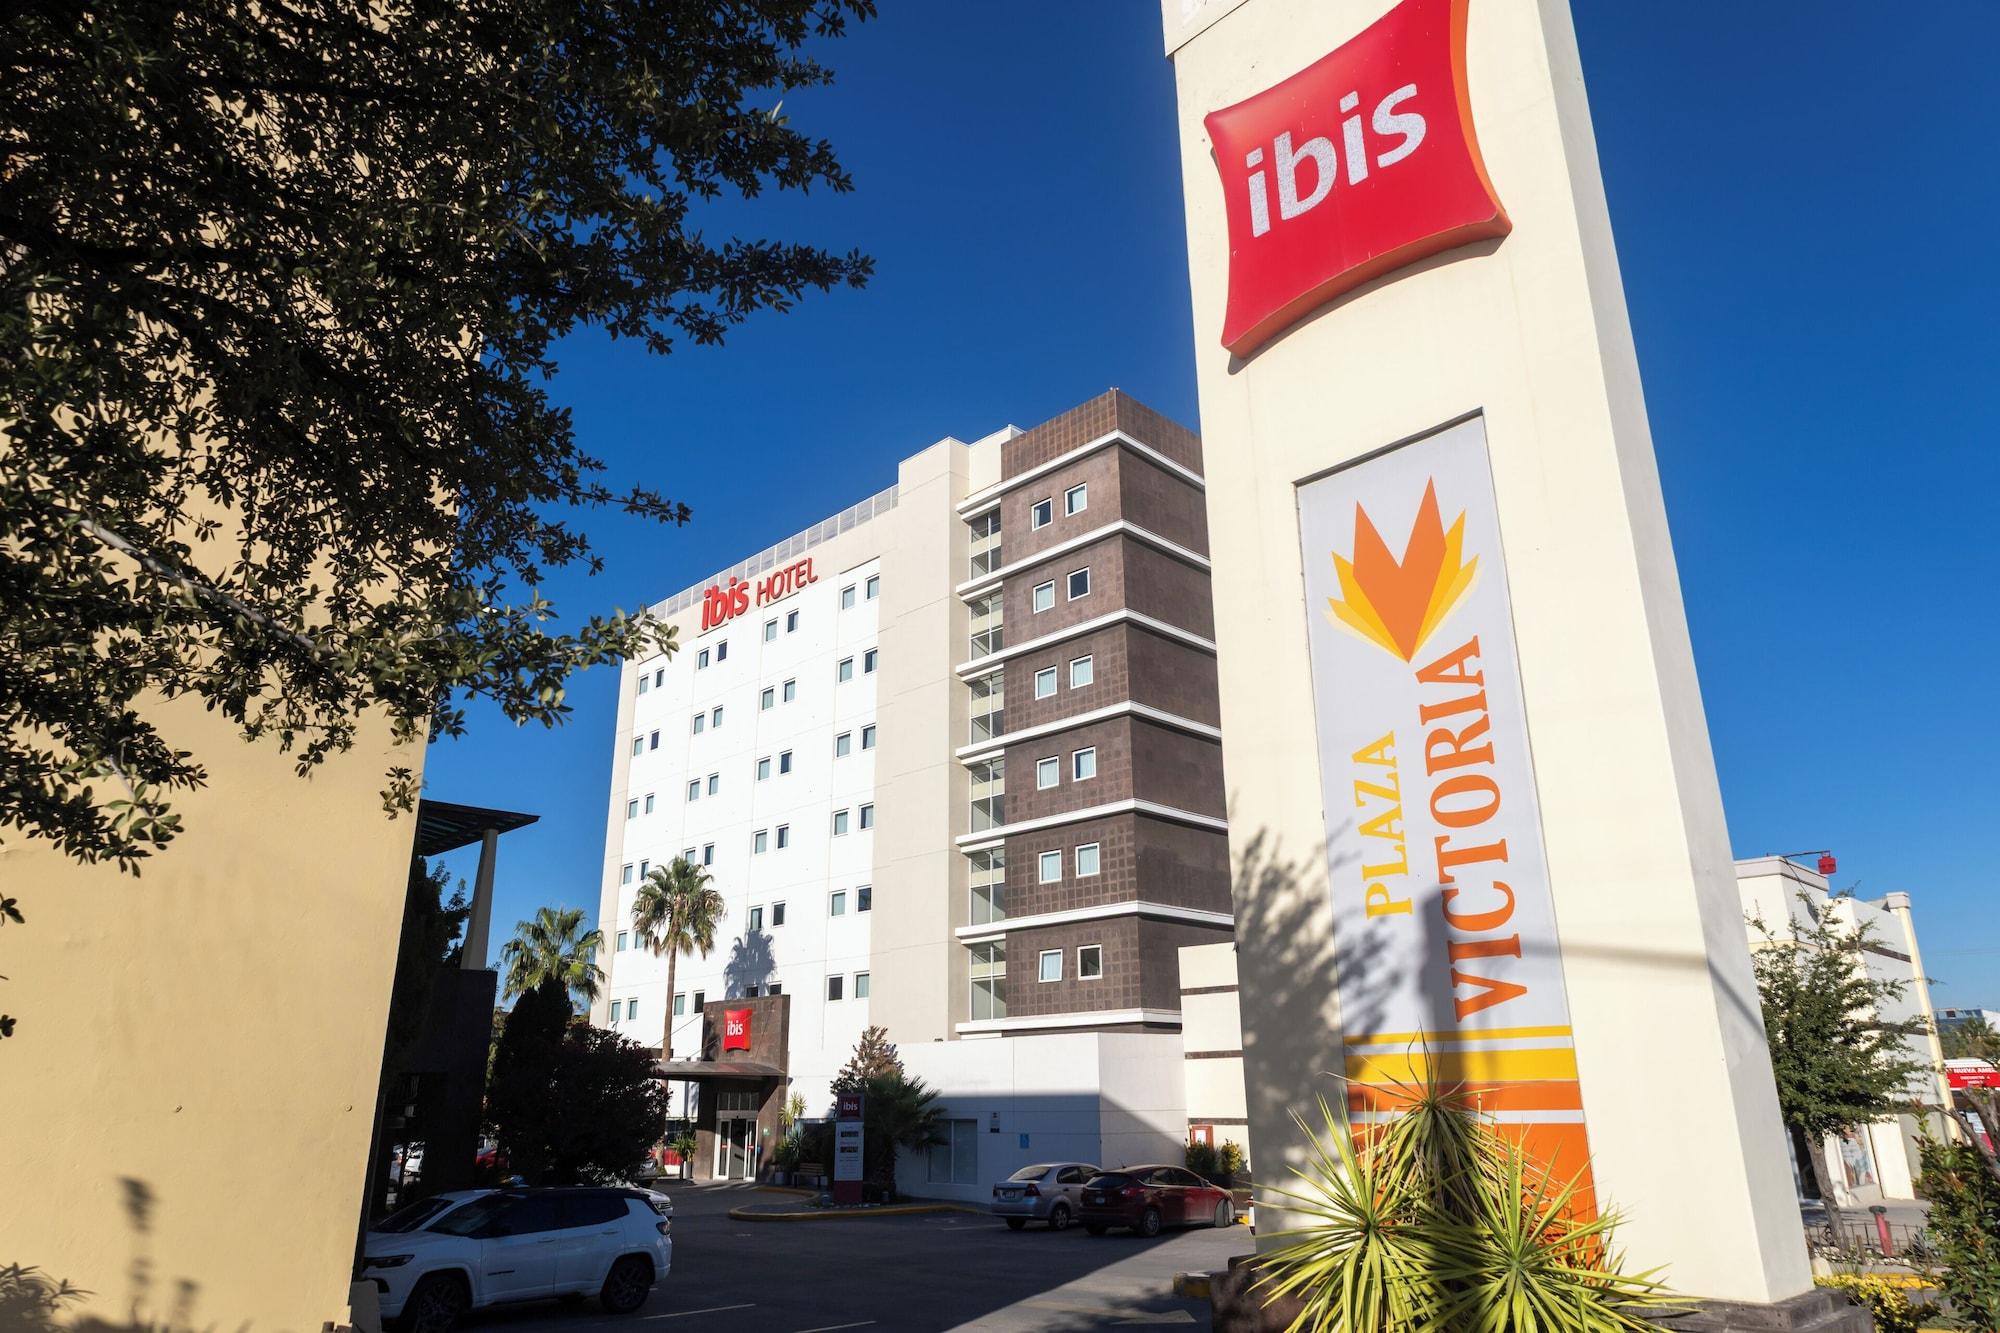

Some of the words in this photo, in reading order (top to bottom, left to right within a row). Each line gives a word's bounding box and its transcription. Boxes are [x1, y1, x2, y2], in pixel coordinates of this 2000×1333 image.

[1246, 84, 1427, 238] ibis
[702, 576, 749, 631] ibis
[756, 557, 818, 607] HOTEL
[1351, 730, 1412, 919] PLAZA
[1415, 635, 1527, 1022] VICTORIA
[727, 1020, 743, 1036] ibis
[842, 1101, 858, 1111] ibis
